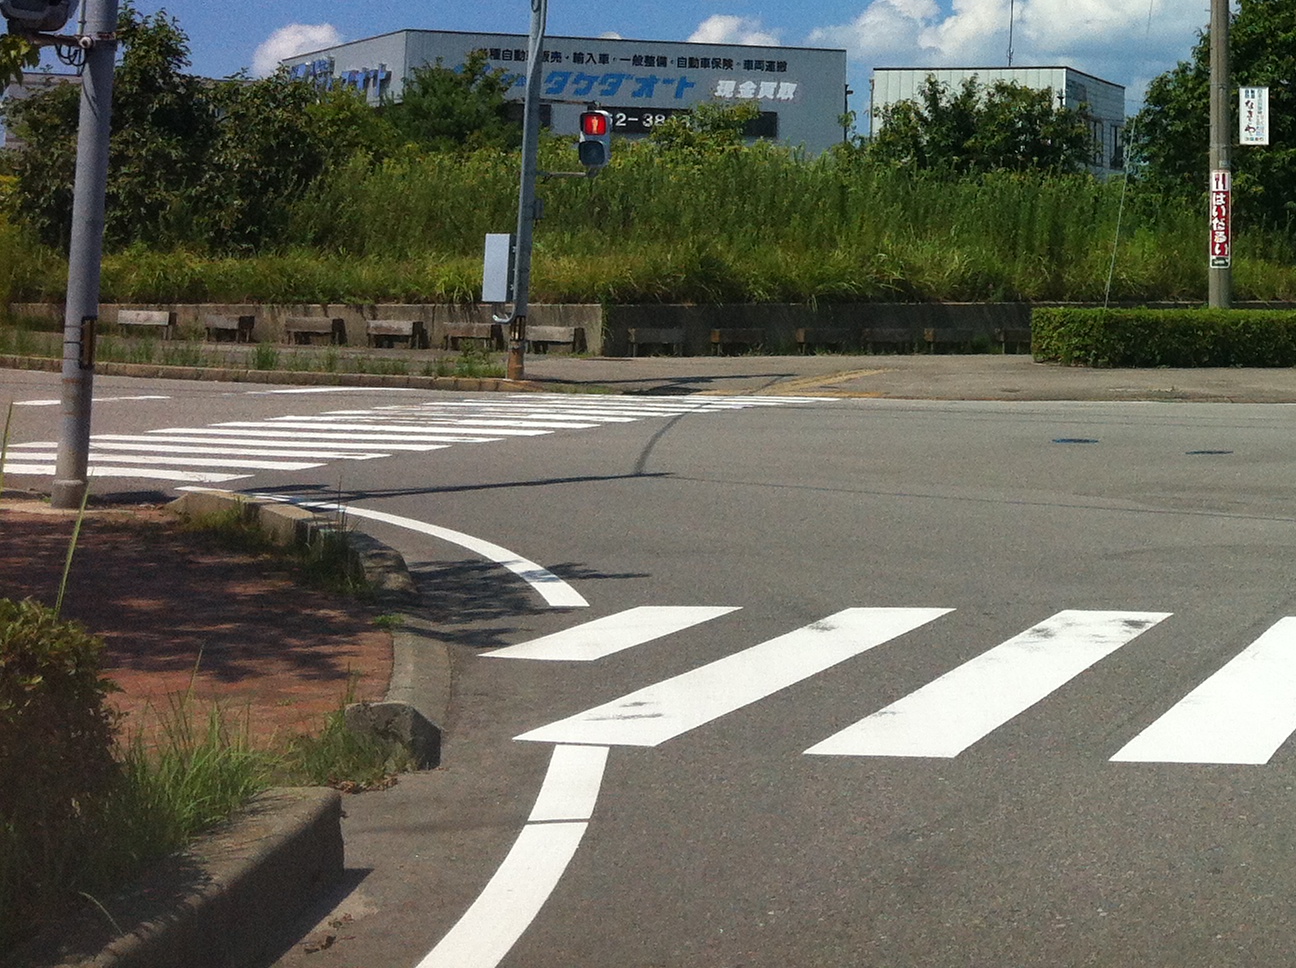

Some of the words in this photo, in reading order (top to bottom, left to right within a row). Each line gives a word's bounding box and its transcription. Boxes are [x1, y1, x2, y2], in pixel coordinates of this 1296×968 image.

[545, 71, 695, 99] タケダオート
[1211, 192, 1229, 255] はいだるい
